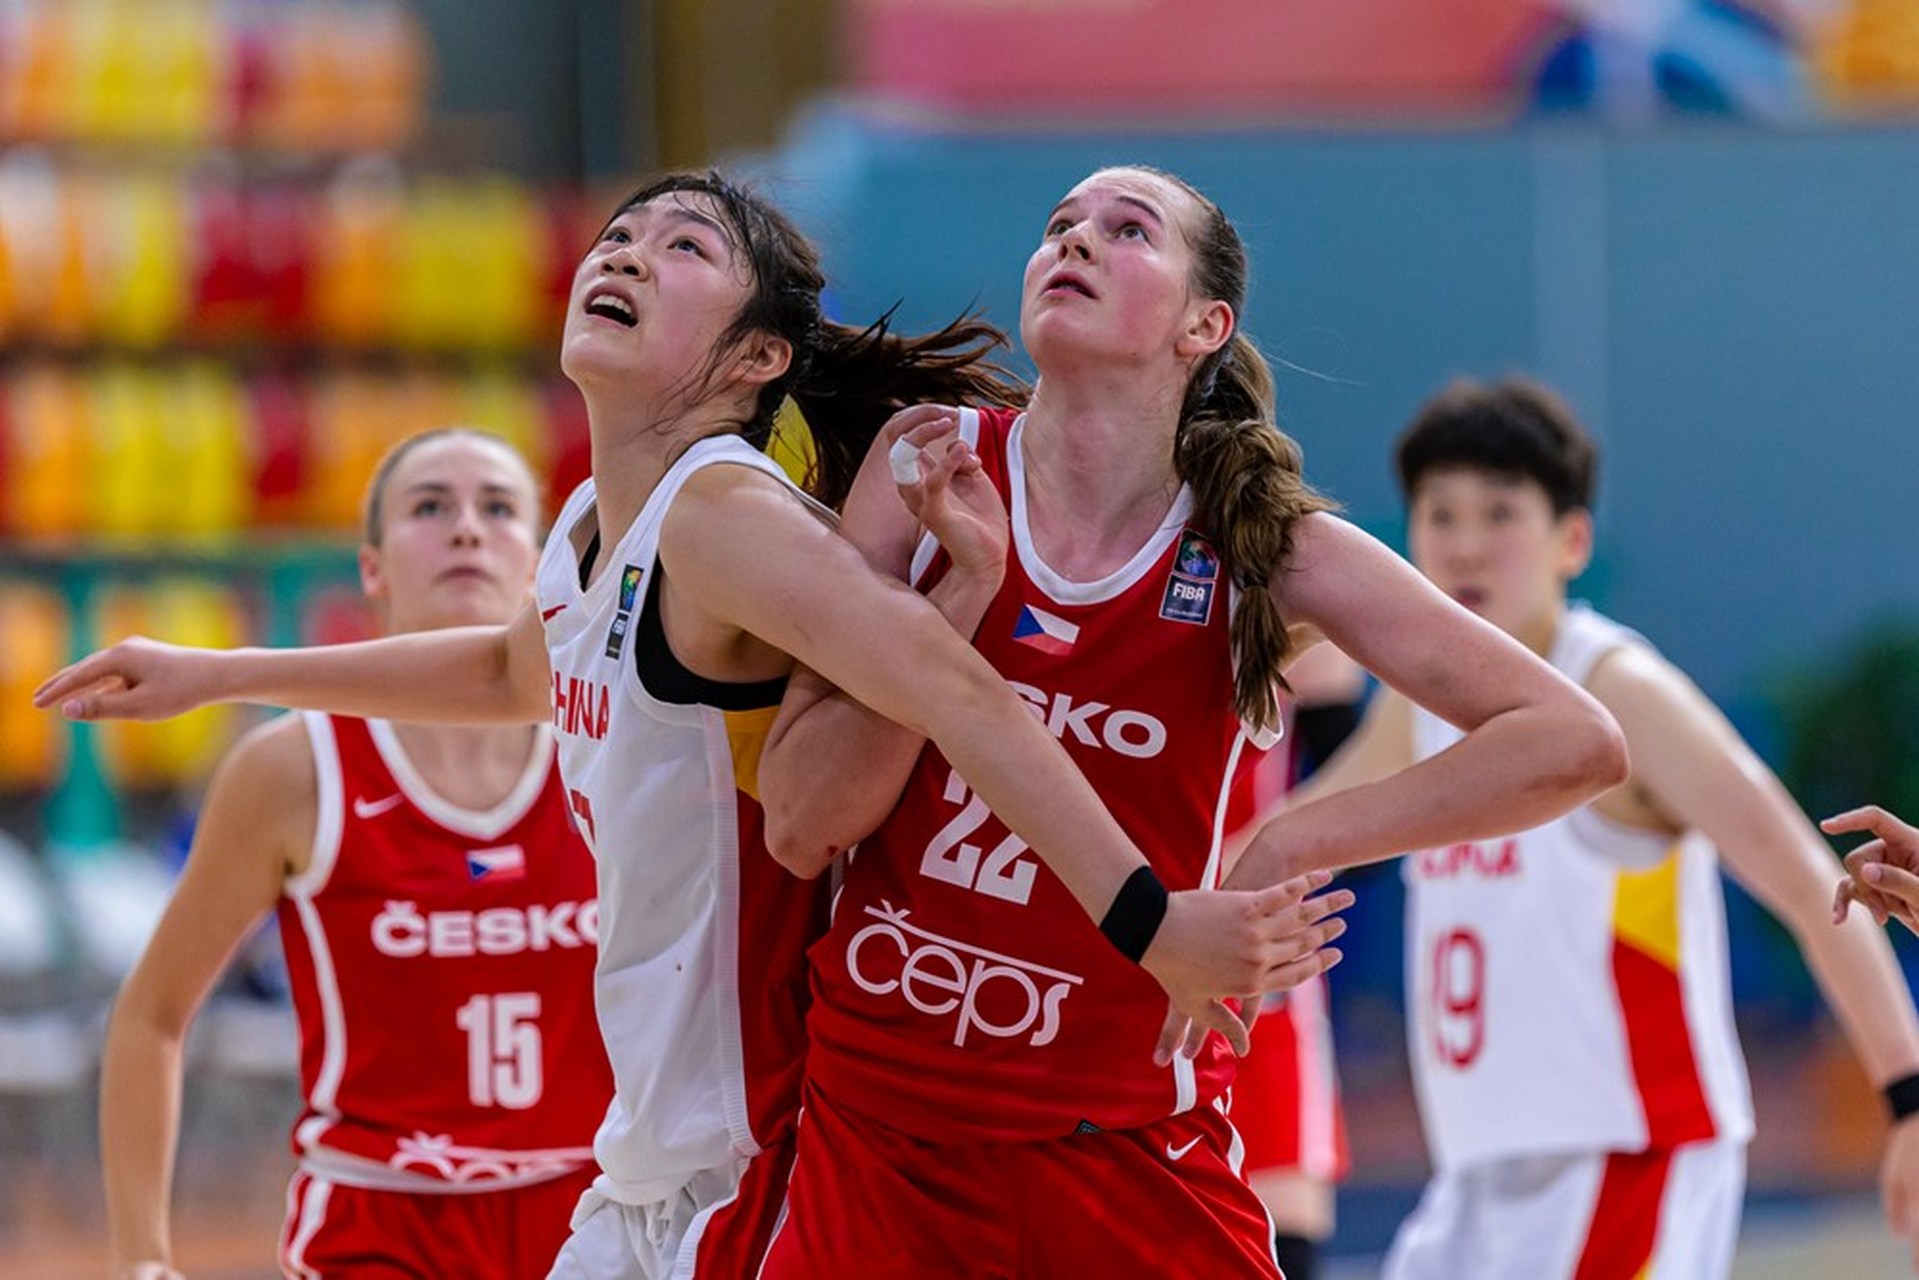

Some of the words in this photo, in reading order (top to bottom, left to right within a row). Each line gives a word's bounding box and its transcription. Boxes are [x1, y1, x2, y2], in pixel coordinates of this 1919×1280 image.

[1172, 582, 1206, 602] FIBA
[550, 670, 610, 740] HINA
[1004, 679, 1167, 759] SKO
[919, 768, 1039, 906] 22
[456, 991, 544, 1110] 15
